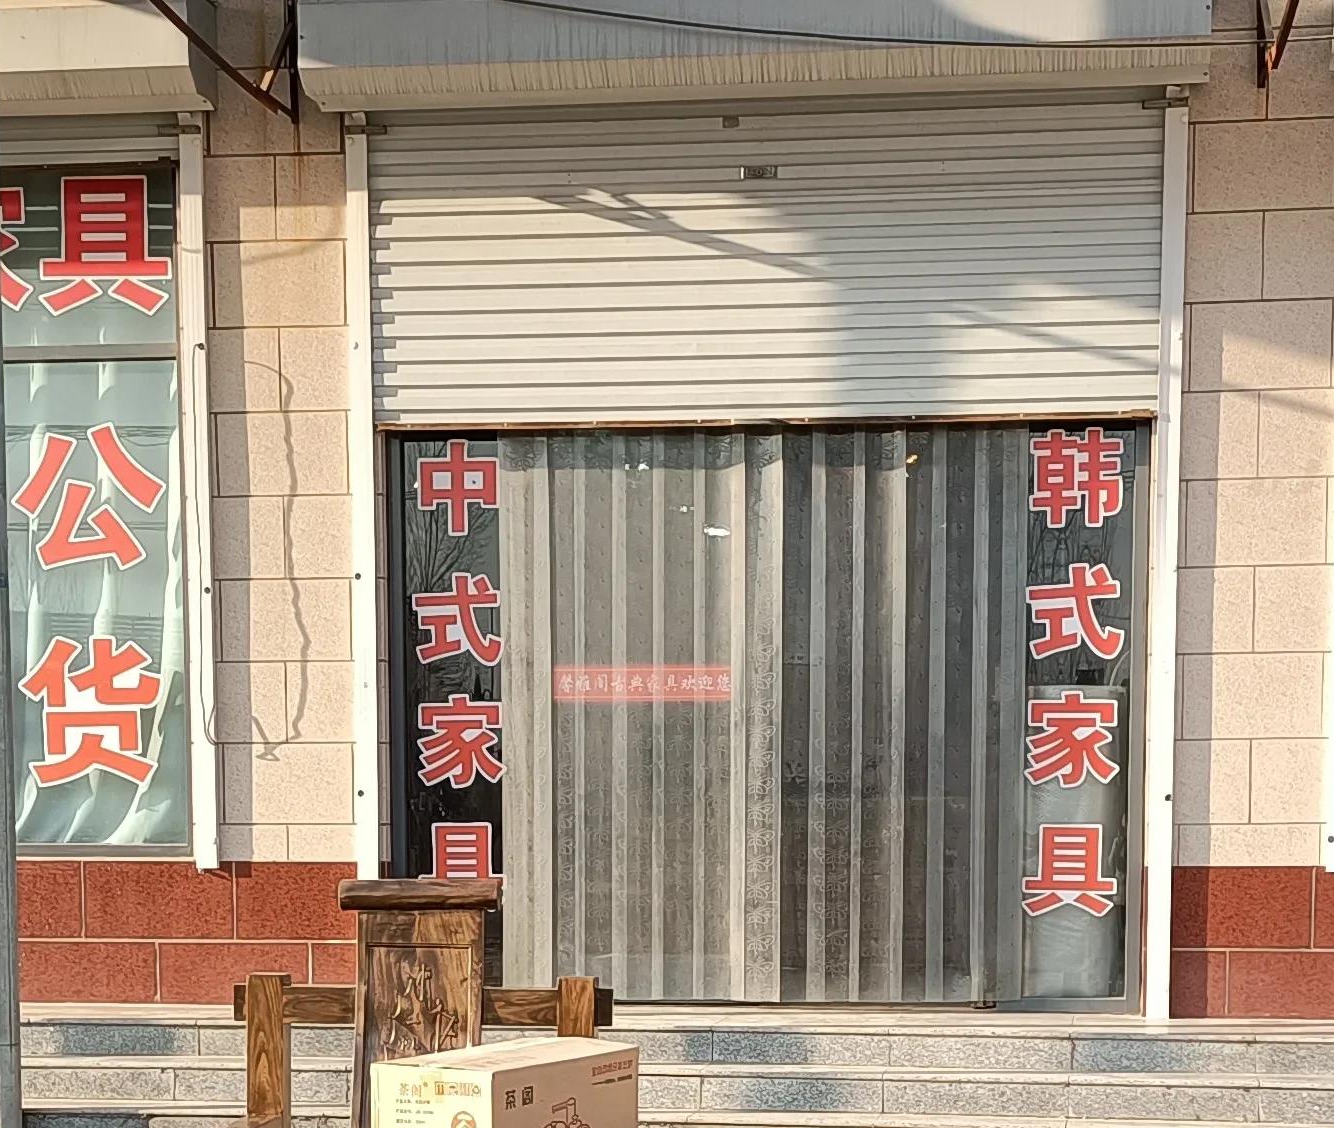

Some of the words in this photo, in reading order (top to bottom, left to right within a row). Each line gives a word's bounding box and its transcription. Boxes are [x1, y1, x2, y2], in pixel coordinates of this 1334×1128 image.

[411, 439, 507, 881] 中式家具
[1021, 425, 1126, 918] 韩式家具
